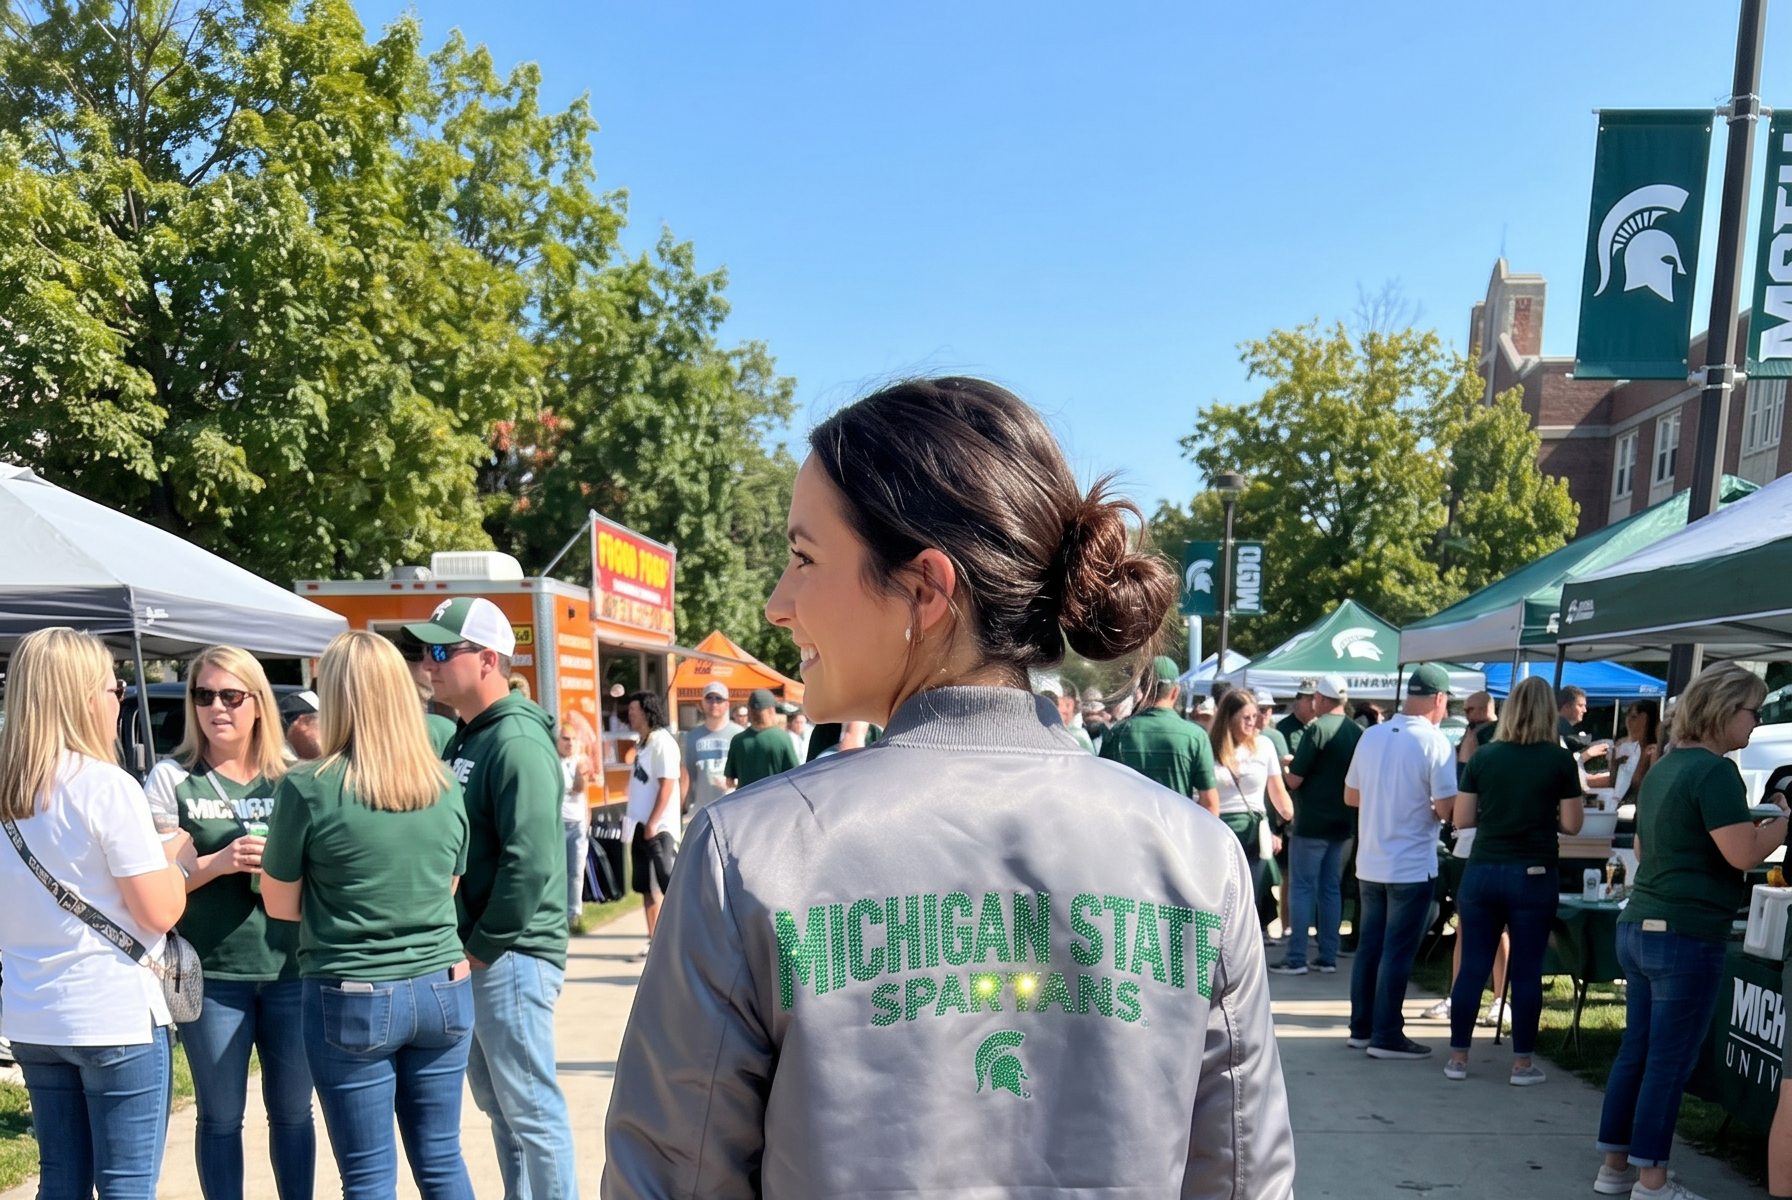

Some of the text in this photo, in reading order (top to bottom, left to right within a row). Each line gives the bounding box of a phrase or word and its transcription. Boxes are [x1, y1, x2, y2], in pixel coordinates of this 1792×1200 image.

[775, 891, 1222, 1012] MICHIGAN STATE
[870, 972, 1142, 1028] SPARTANS
[1725, 1041, 1779, 1093] UNIV
